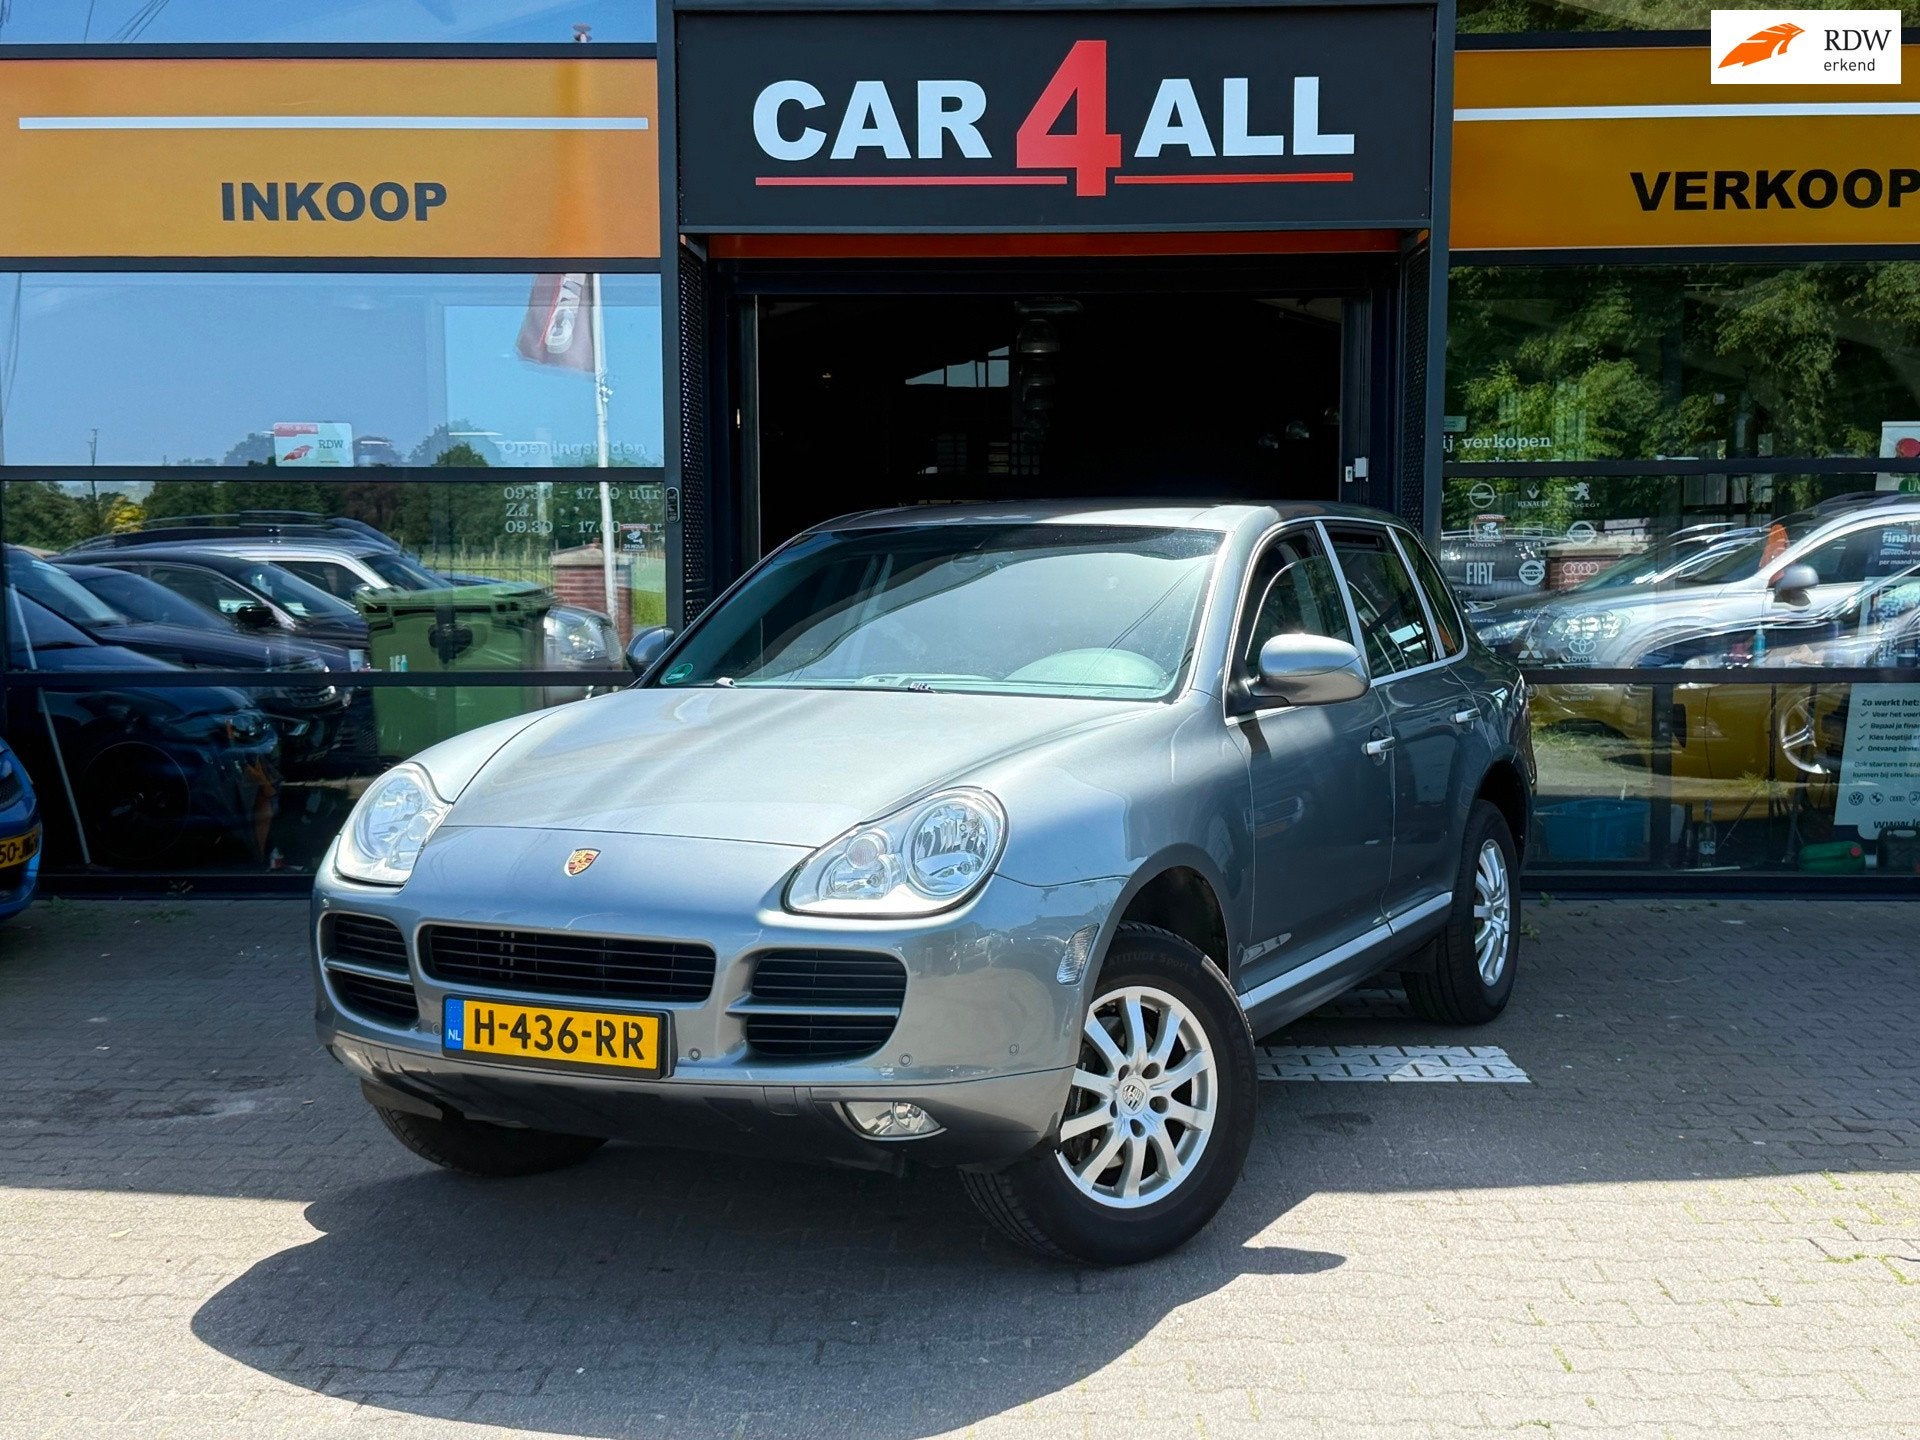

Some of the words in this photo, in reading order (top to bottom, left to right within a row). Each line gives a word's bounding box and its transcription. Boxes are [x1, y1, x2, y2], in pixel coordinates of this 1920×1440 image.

[752, 79, 993, 161] CAR
[1016, 39, 1122, 196] 4
[1134, 76, 1355, 158] ALL
[1629, 168, 1920, 211] VERKOOP
[221, 181, 447, 221] INKOOP
[318, 439, 345, 449] RDW
[1443, 435, 1454, 453] ij
[1462, 433, 1552, 451] verkopen
[576, 486, 620, 500] 17.0
[628, 486, 662, 500] uur
[505, 504, 534, 517] Za.
[1517, 500, 1549, 508] RENAULT
[505, 520, 553, 533] 09.30
[1465, 562, 1496, 585] FIAT
[1567, 655, 1599, 663] TOYOTA
[448, 1029, 462, 1041] NL
[474, 1008, 645, 1060] H-436-RR
